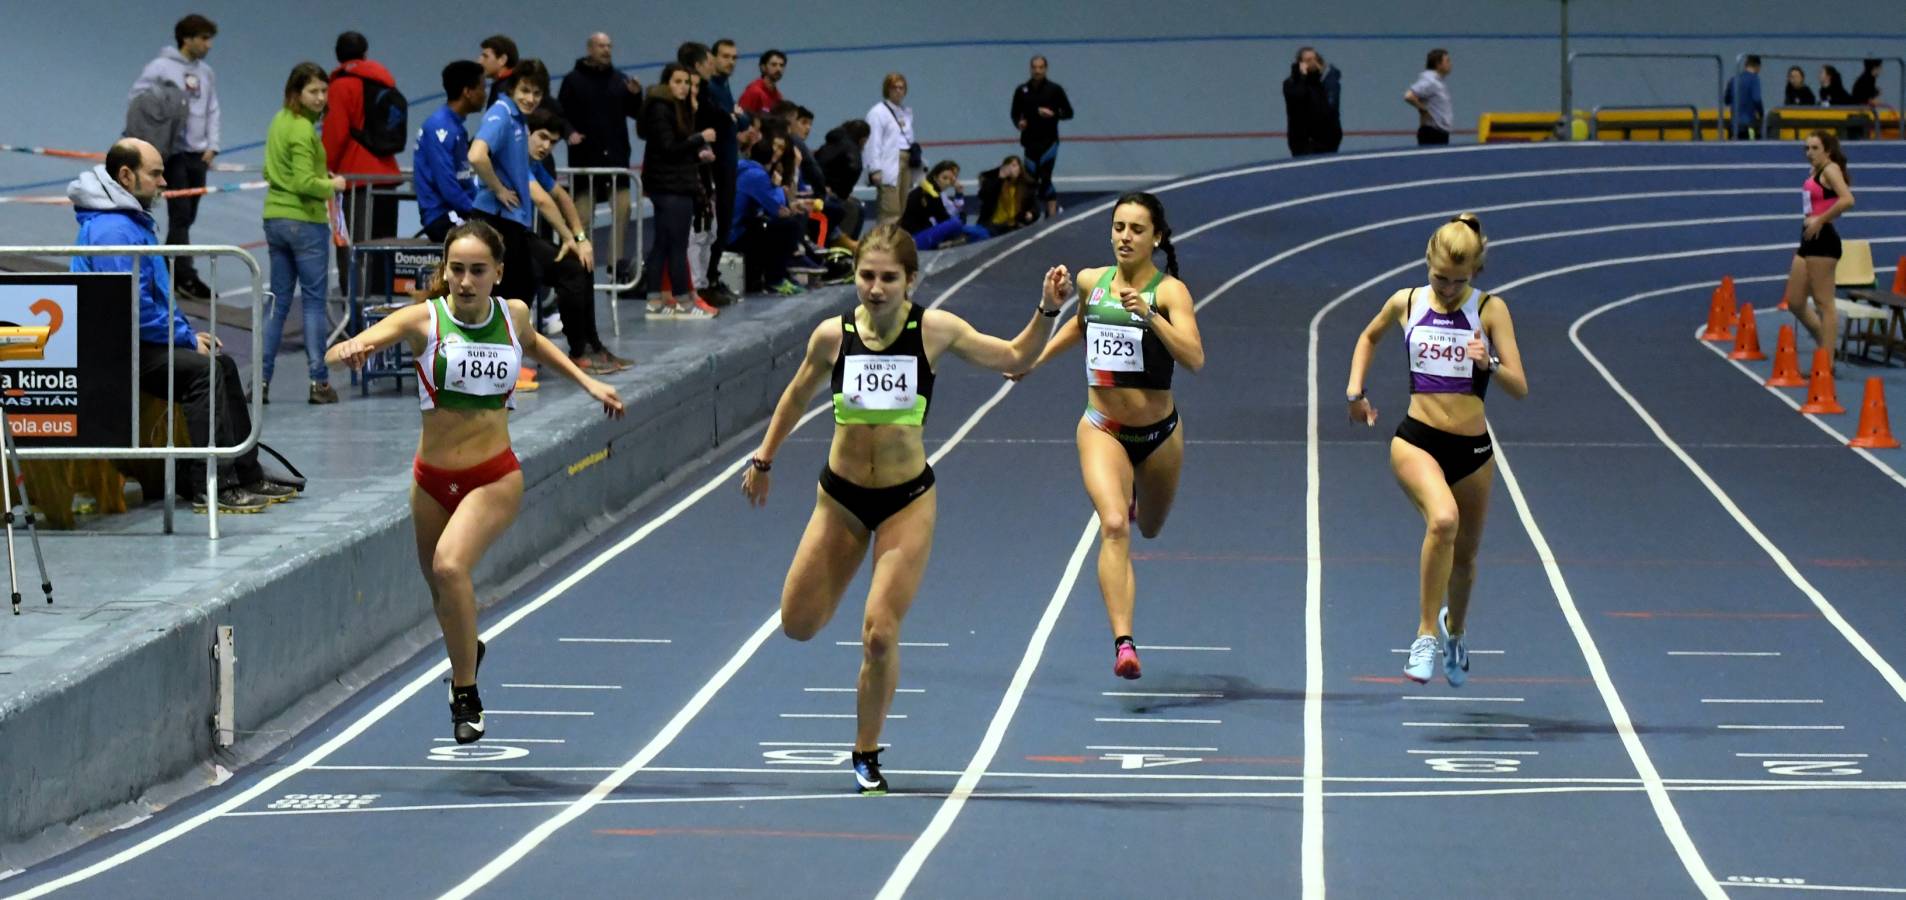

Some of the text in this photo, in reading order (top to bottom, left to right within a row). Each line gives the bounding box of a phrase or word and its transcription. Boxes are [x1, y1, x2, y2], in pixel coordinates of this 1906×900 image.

[394, 251, 441, 265] Donostia
[1093, 338, 1135, 357] 1523
[1418, 342, 1466, 362] 2549
[457, 360, 508, 379] 1846
[18, 370, 78, 389] kirola
[854, 372, 908, 392] 1964
[0, 395, 78, 406] ASTIÁN
